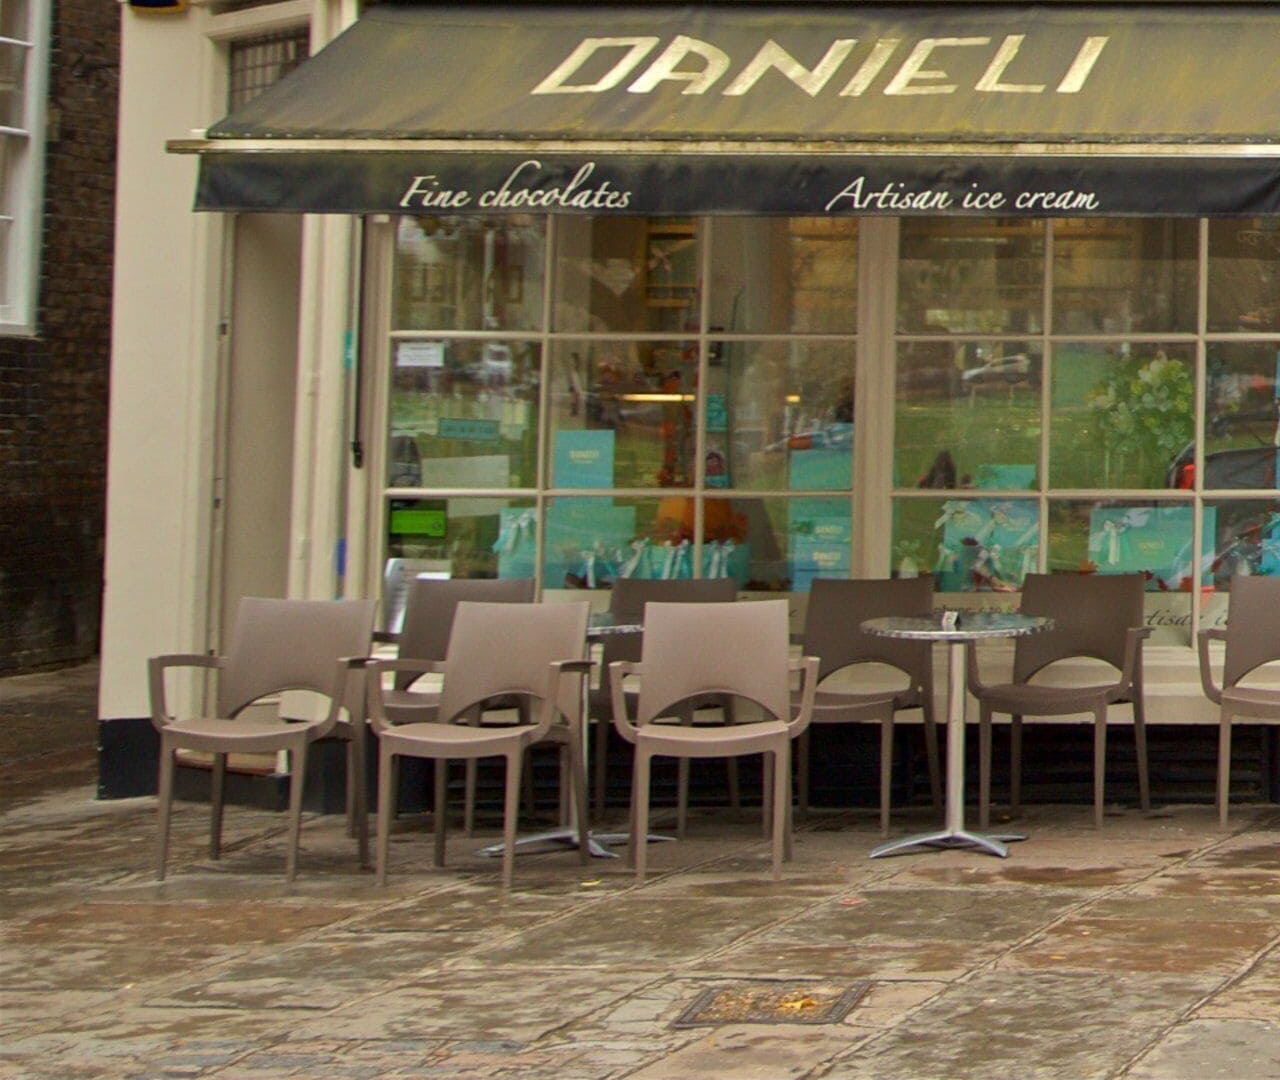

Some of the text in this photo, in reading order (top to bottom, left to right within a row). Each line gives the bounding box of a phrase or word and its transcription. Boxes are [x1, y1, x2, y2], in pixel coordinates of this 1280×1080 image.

[530, 34, 1110, 97] DANIELI
[400, 160, 633, 209] Fine chocolates
[825, 176, 1100, 211] Artisan ice cream
